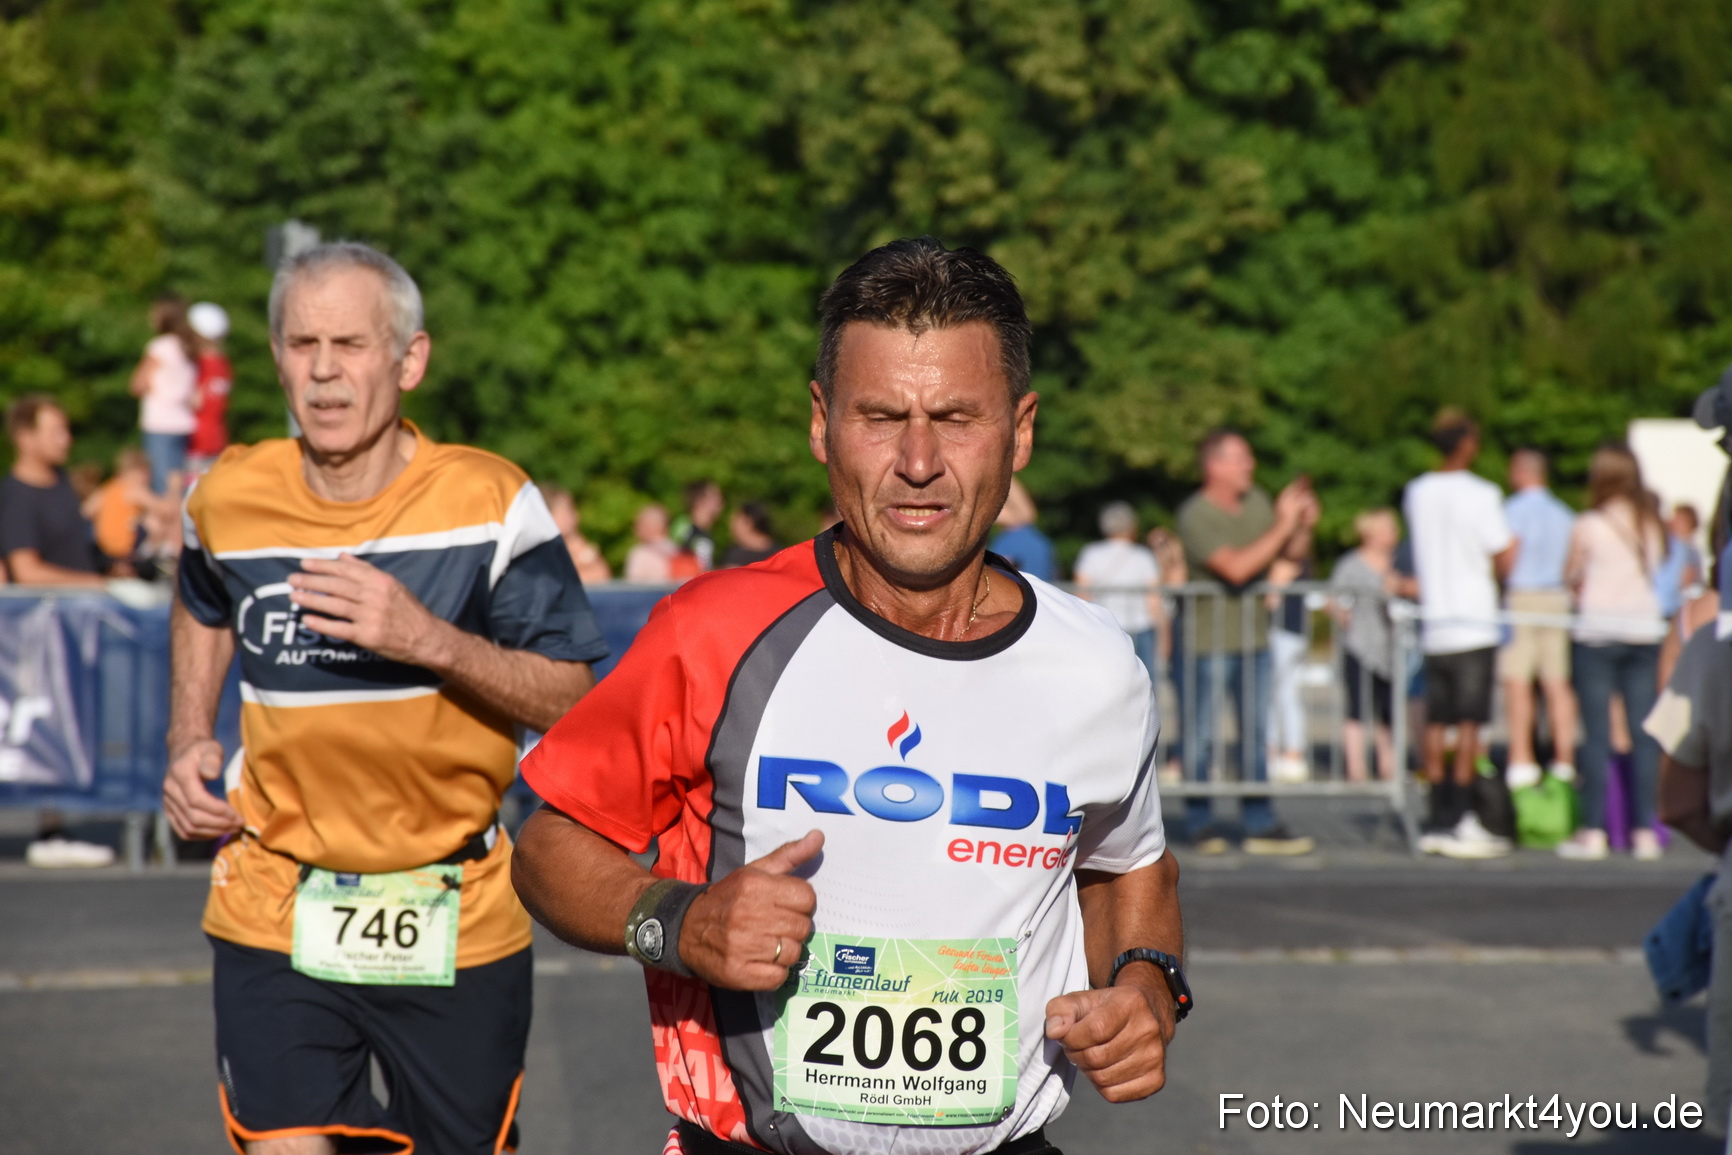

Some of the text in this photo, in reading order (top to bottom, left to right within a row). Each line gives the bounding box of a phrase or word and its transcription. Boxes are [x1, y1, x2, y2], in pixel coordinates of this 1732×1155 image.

[262, 600, 346, 646] Fis
[333, 906, 419, 948] 746
[841, 950, 869, 961] Fischer
[814, 987, 856, 997] neumarkt
[815, 969, 912, 993] firmenlauf
[965, 989, 1004, 1004] 2019
[803, 1001, 987, 1072] 2068
[805, 1068, 988, 1096] Herrmann Wolfgang
[860, 1092, 932, 1106] Rödl GmbH
